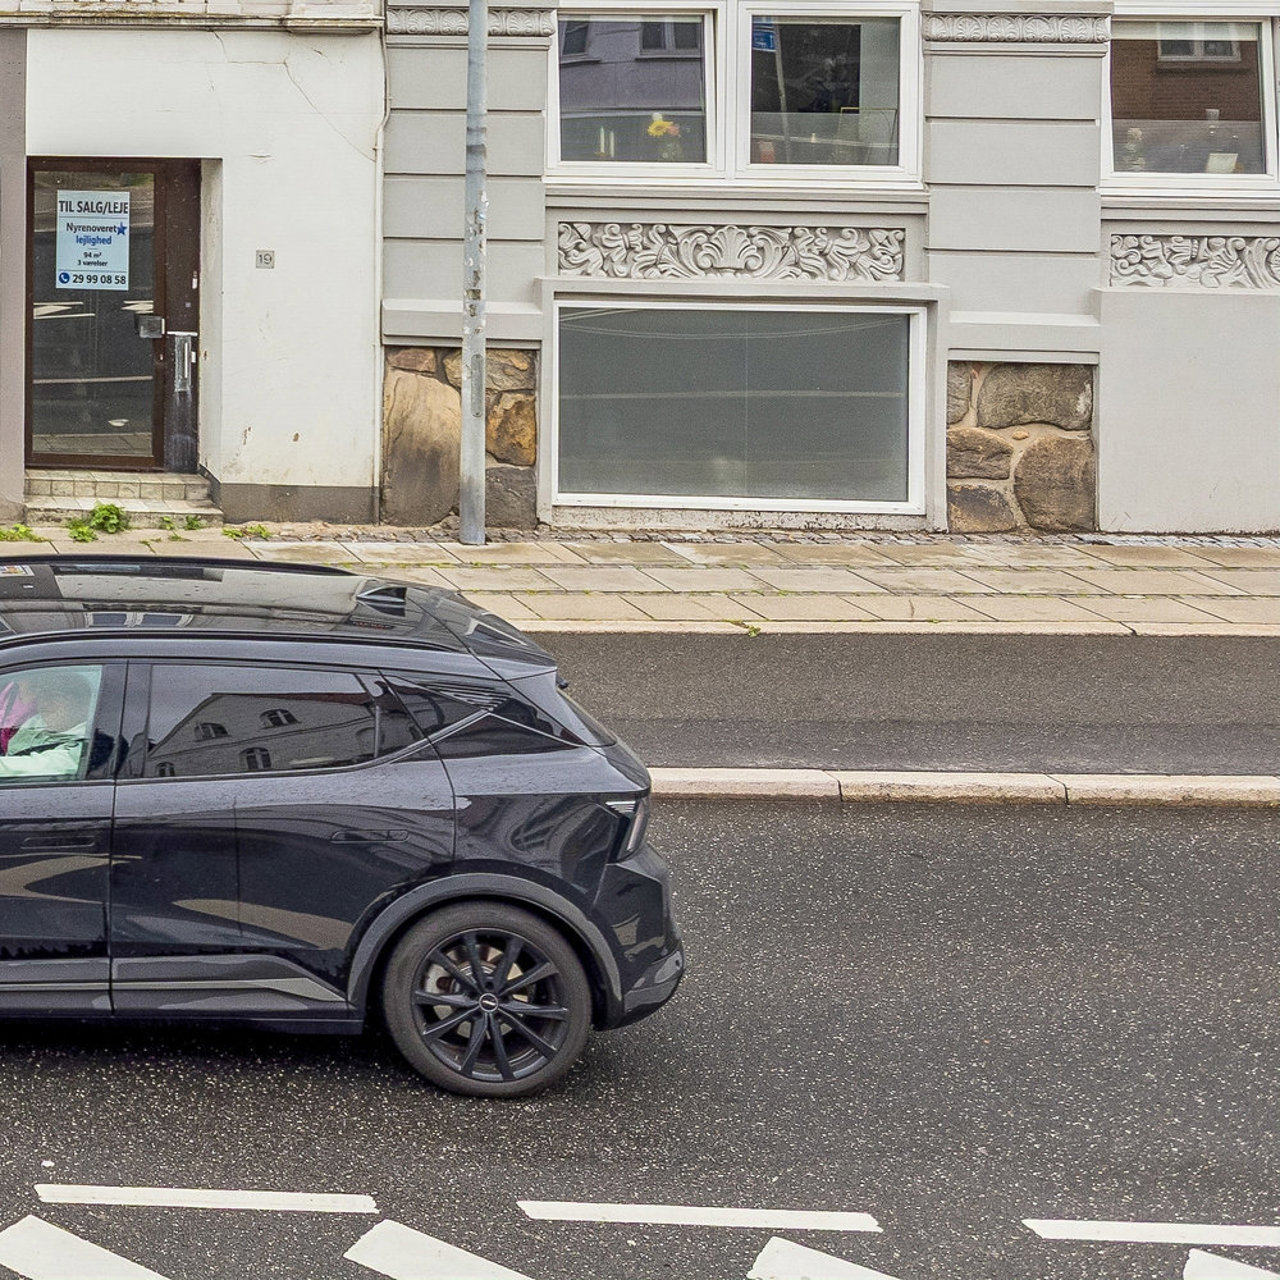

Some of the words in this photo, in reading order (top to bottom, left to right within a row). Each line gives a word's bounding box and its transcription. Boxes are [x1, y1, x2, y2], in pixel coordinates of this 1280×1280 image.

[59, 201, 74, 212] TIL
[77, 201, 128, 214] SALG/LEJE
[66, 223, 117, 233] Nyrenoveret
[76, 235, 112, 246] lejlighed
[259, 253, 272, 265] 19
[72, 274, 84, 283] 29
[86, 275, 98, 283] 99
[100, 275, 112, 284] 08
[114, 275, 126, 284] 58
